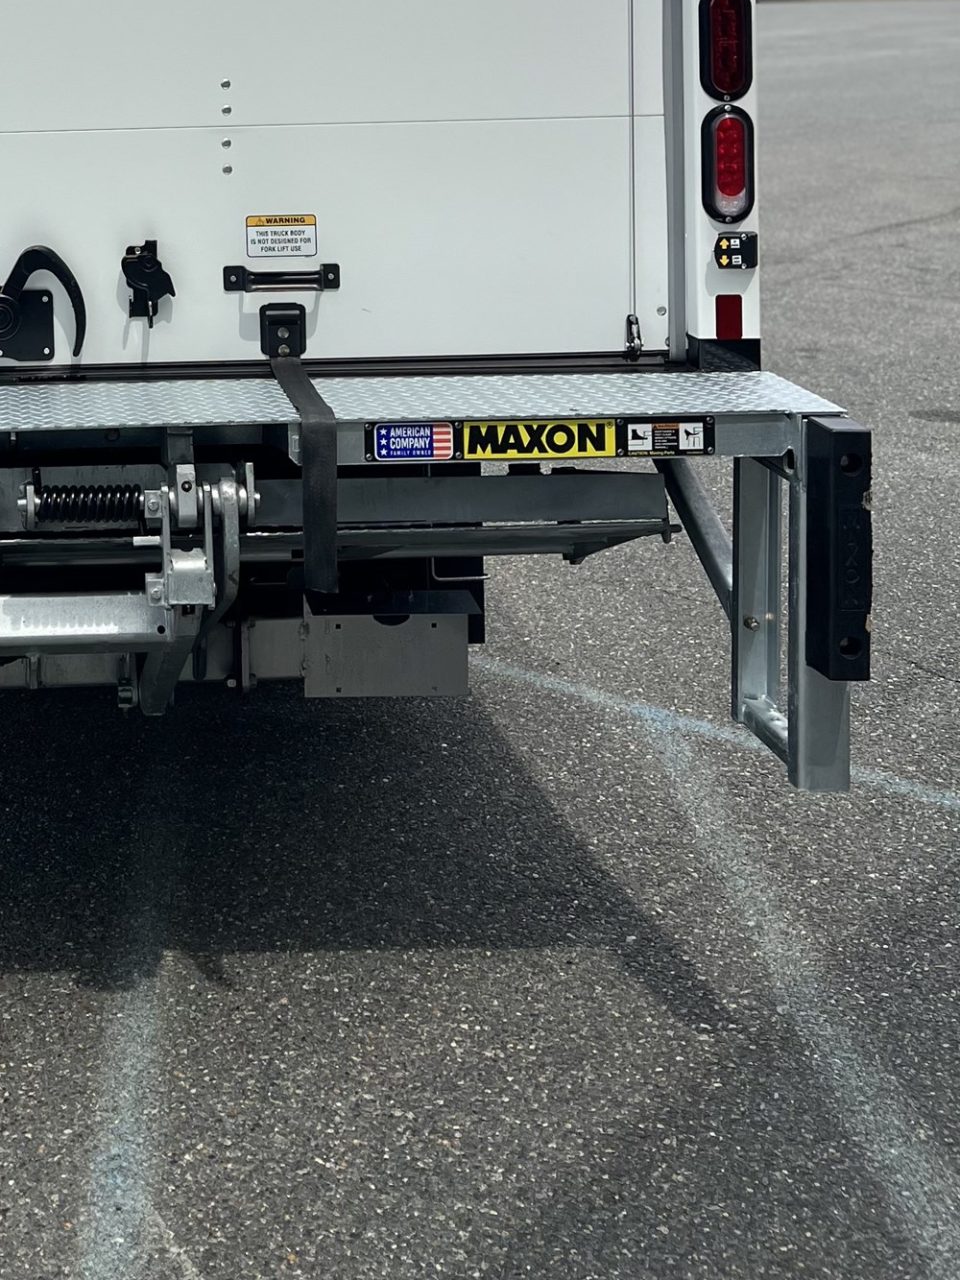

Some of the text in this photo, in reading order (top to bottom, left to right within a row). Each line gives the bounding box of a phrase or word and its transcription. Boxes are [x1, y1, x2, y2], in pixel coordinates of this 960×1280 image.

[390, 426, 431, 437] AMERICAN
[390, 437, 431, 449] COMPANY
[468, 423, 606, 454] MAXON
